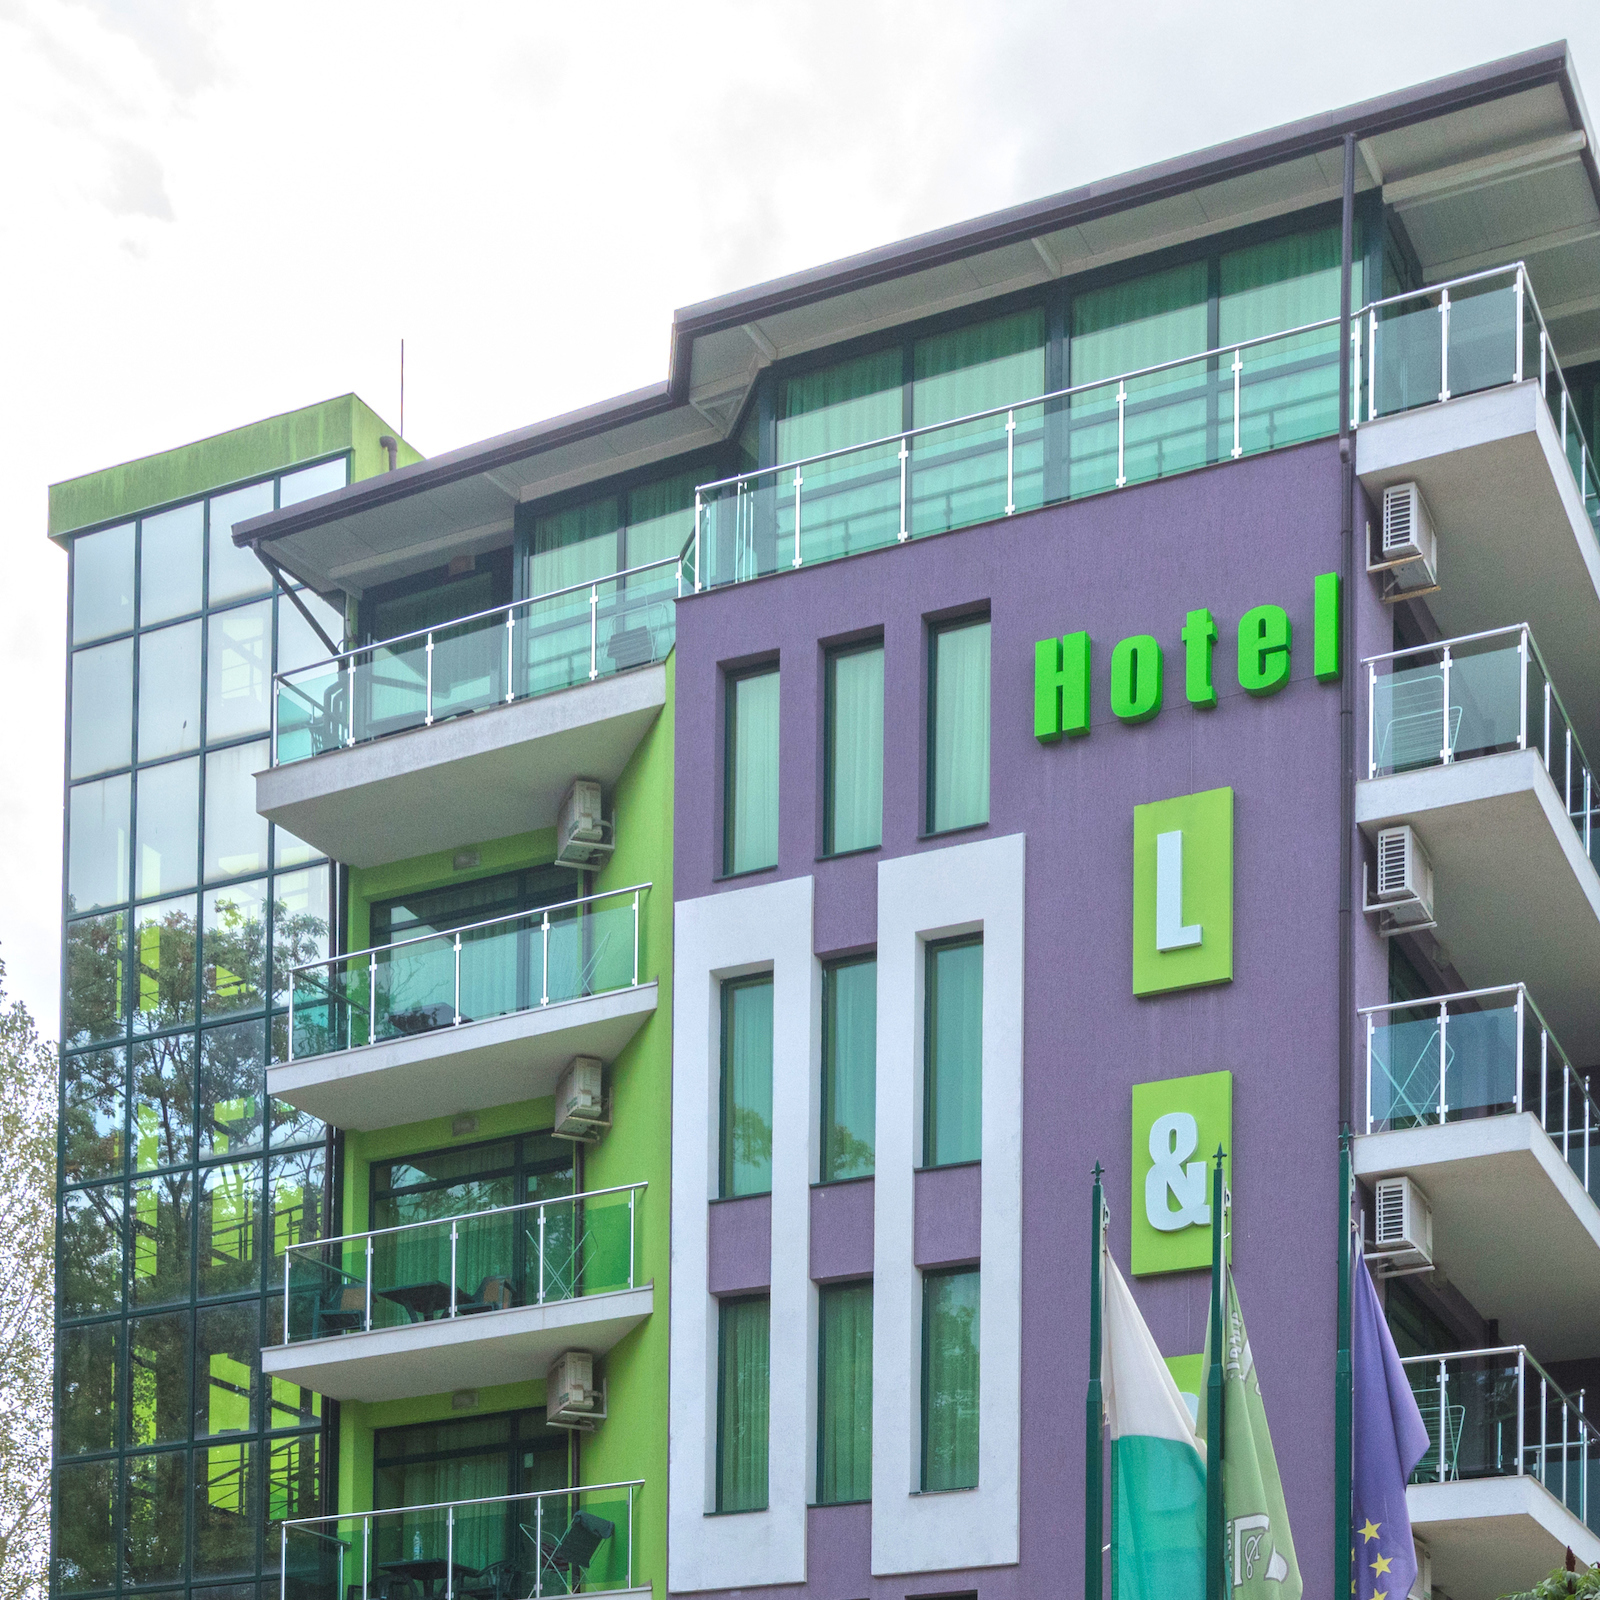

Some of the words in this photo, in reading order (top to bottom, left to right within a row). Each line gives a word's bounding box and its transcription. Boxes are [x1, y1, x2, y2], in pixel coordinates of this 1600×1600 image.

[1034, 571, 1340, 745] Hotel
[1156, 830, 1203, 952] L
[1145, 1111, 1211, 1232] &
